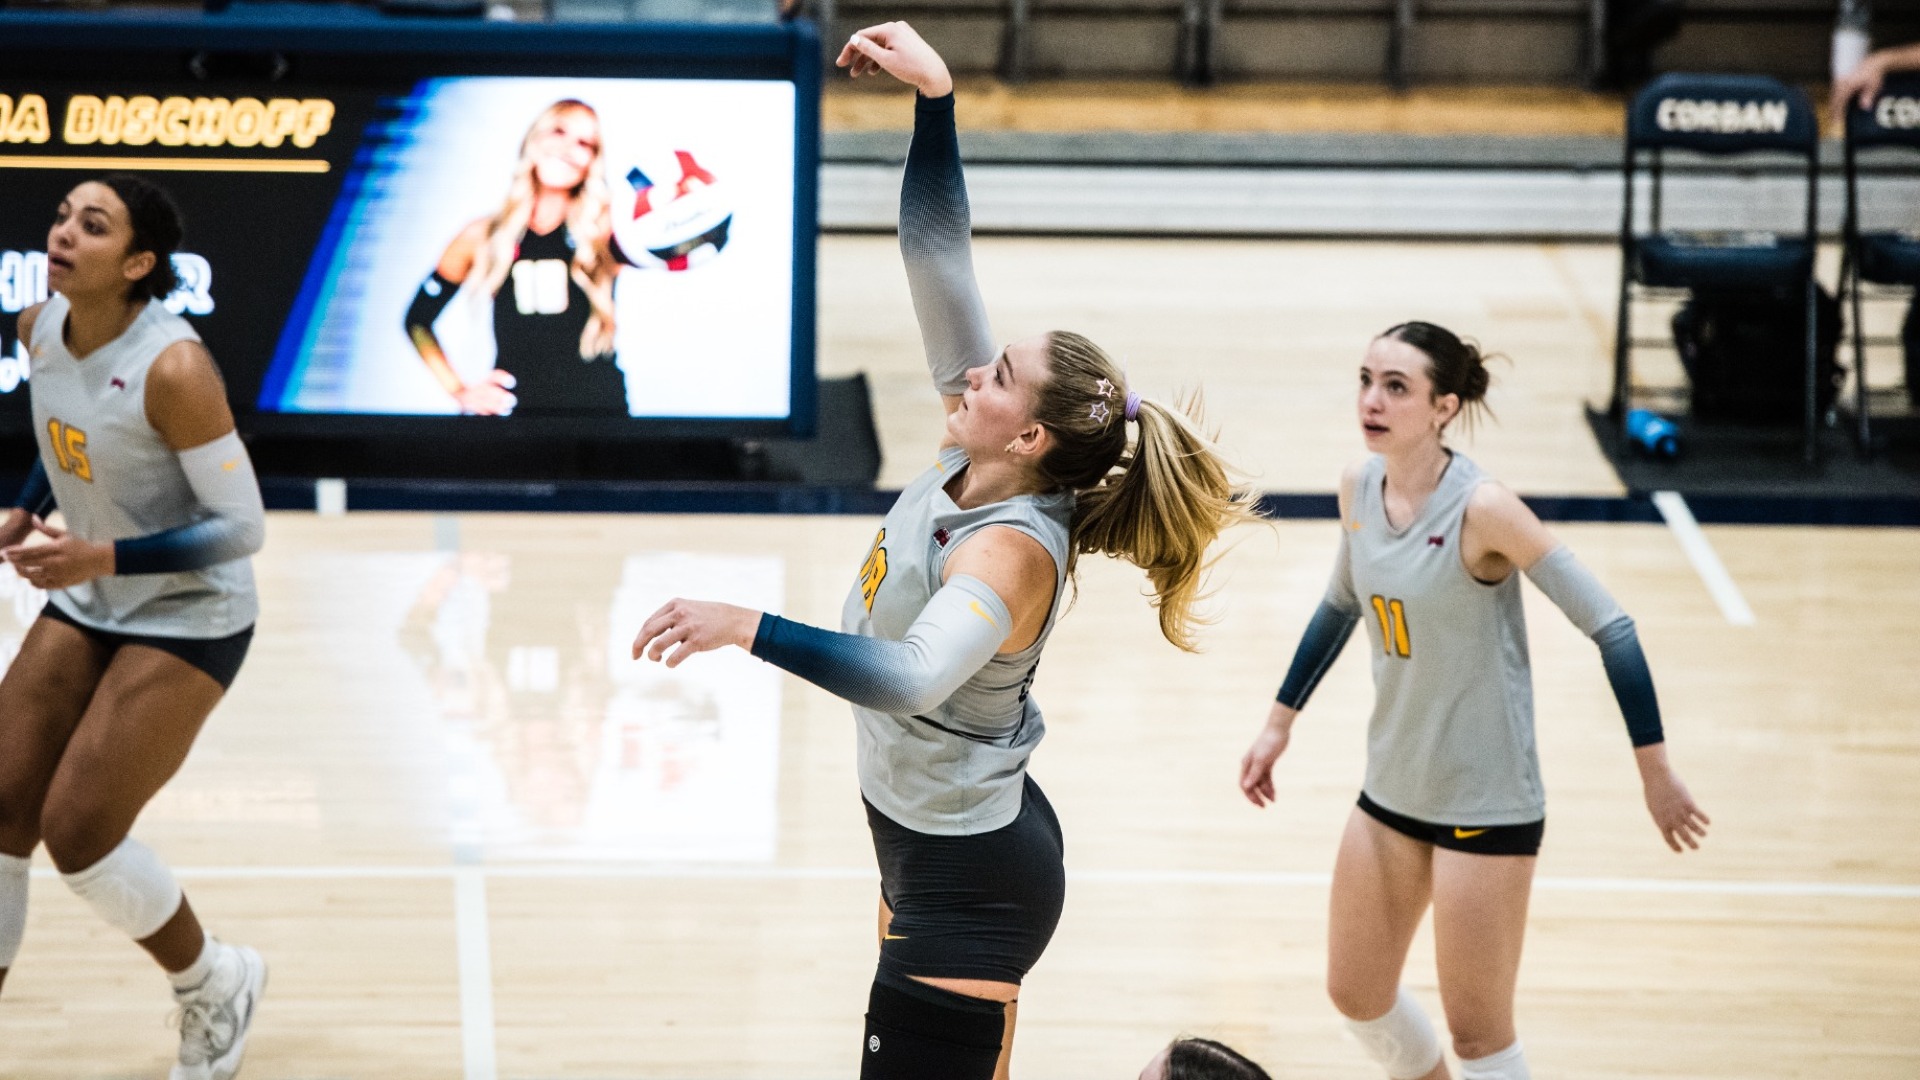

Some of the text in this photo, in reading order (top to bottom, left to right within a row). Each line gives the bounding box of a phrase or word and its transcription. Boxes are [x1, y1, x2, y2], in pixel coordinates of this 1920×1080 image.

[64, 95, 335, 148] BISCHOFF
[1656, 98, 1788, 133] CORBAN
[47, 416, 93, 483] 15
[1370, 594, 1412, 659] 11
